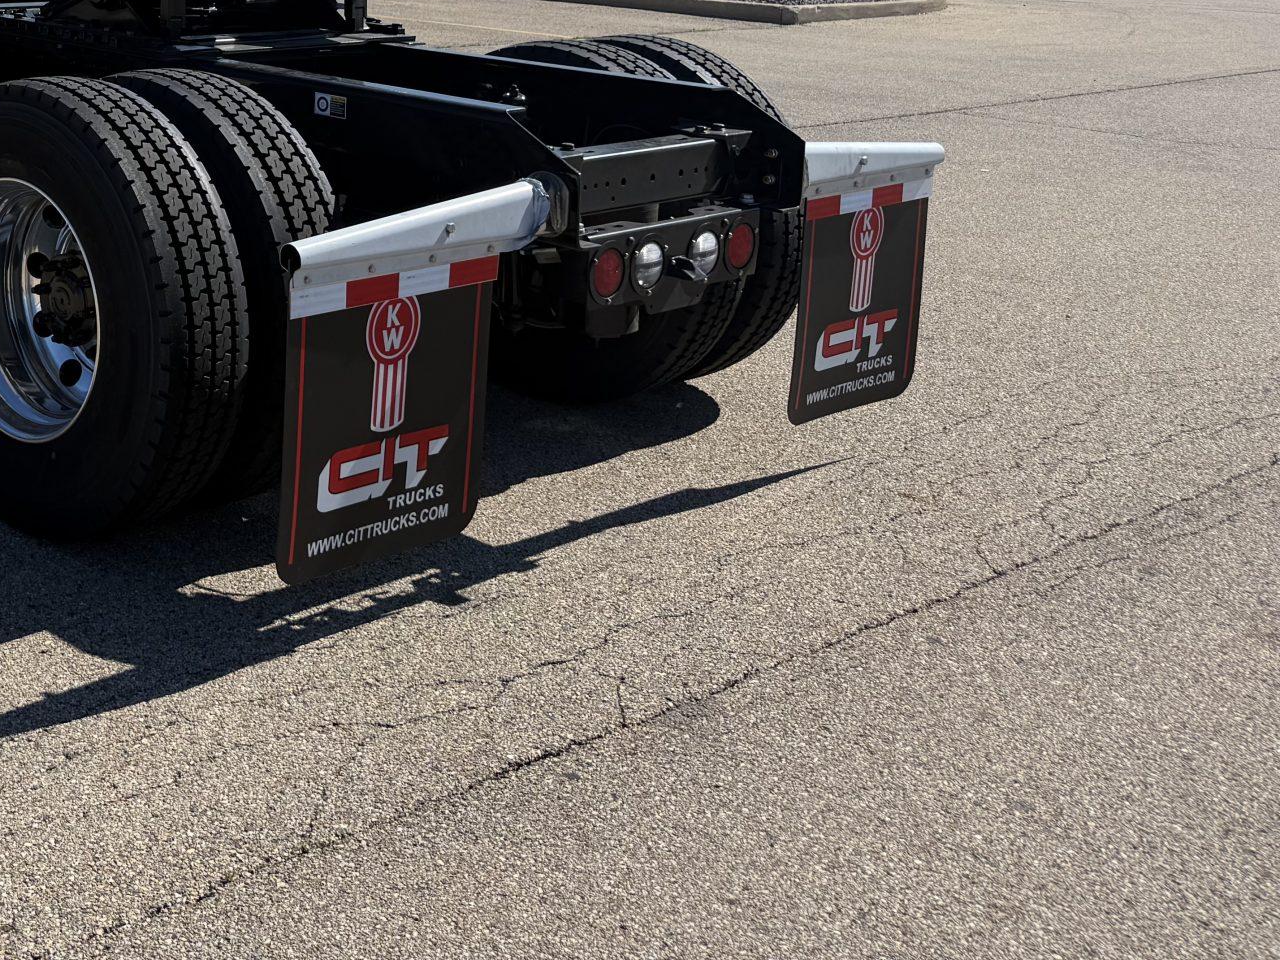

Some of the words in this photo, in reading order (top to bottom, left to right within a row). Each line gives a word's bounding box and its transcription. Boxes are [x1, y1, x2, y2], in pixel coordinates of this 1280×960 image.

[814, 308, 898, 372] CIT
[856, 354, 893, 373] TRUCKS
[806, 370, 895, 406] WWW.CITTRUCKS.COM
[317, 424, 450, 513] CIT
[387, 483, 445, 511] TRUCKS
[307, 503, 449, 558] WWW.CITTRUCKS.COM
